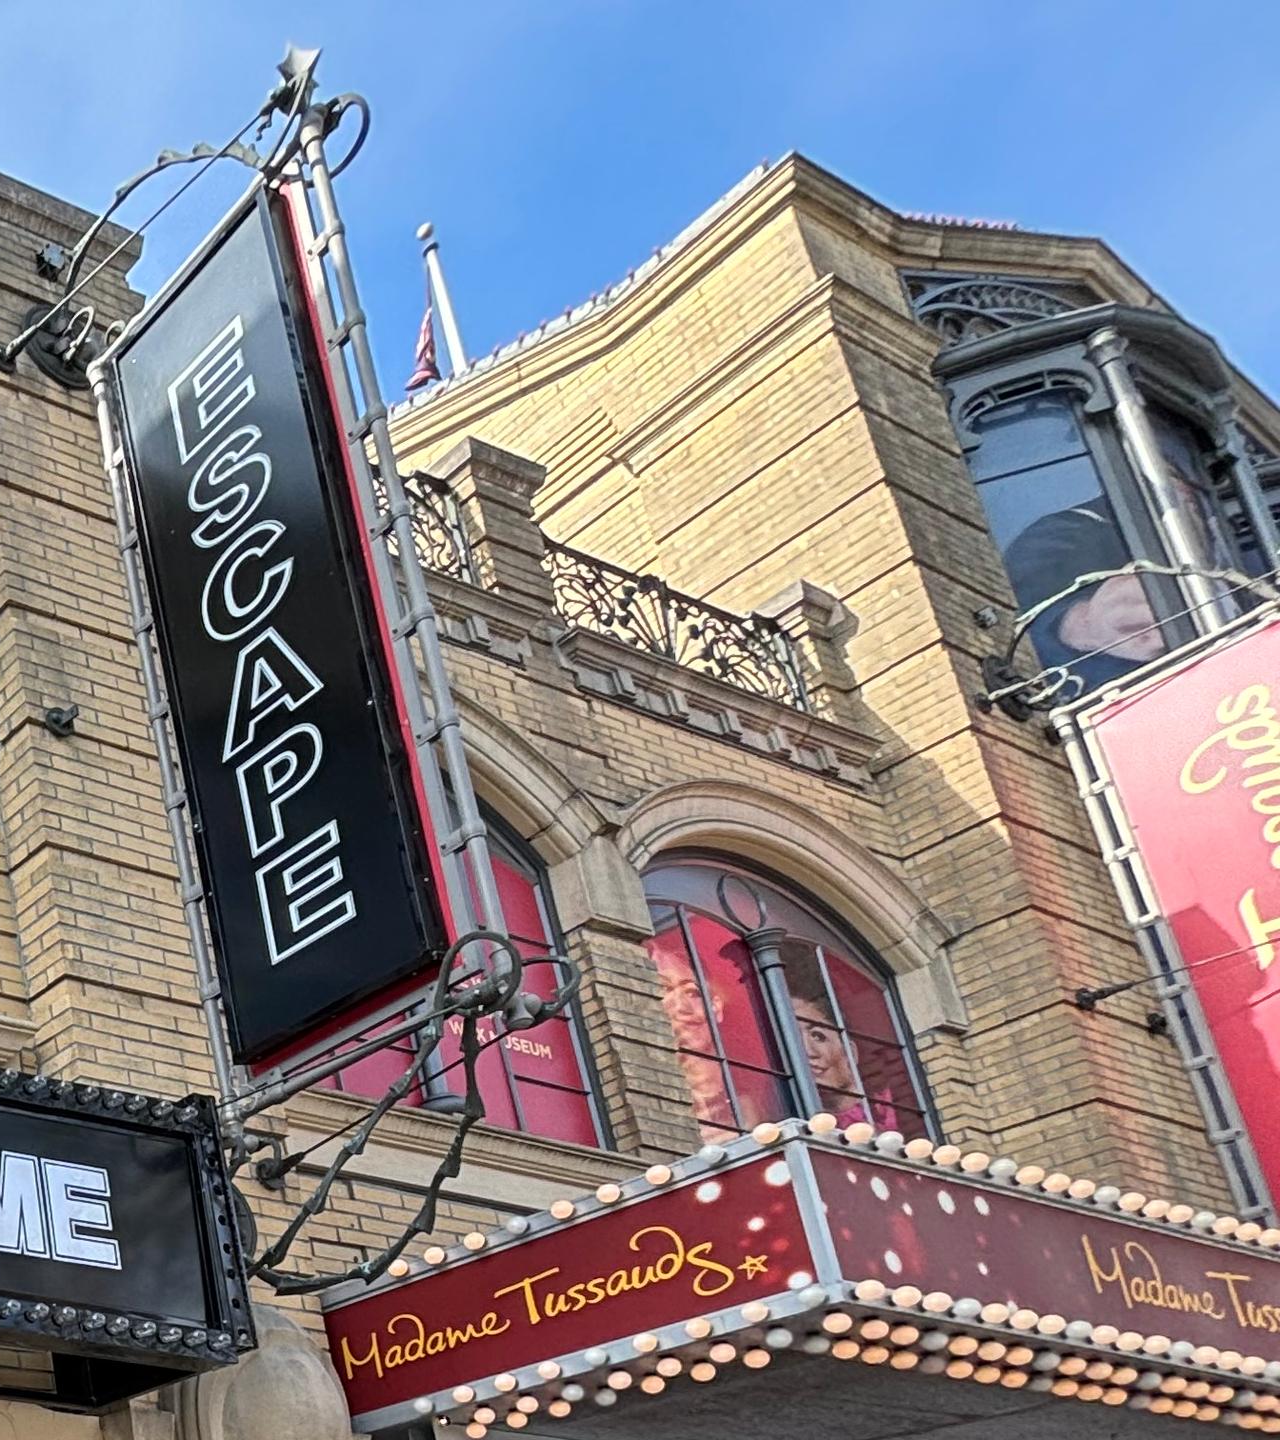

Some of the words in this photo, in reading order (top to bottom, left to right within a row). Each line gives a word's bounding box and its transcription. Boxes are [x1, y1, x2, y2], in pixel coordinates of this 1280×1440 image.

[168, 315, 356, 967] ESCAPE
[448, 1019, 487, 1043] WX
[340, 1313, 511, 1381] Madame
[494, 1226, 735, 1326] Tussauds
[1081, 1234, 1225, 1320] Madame
